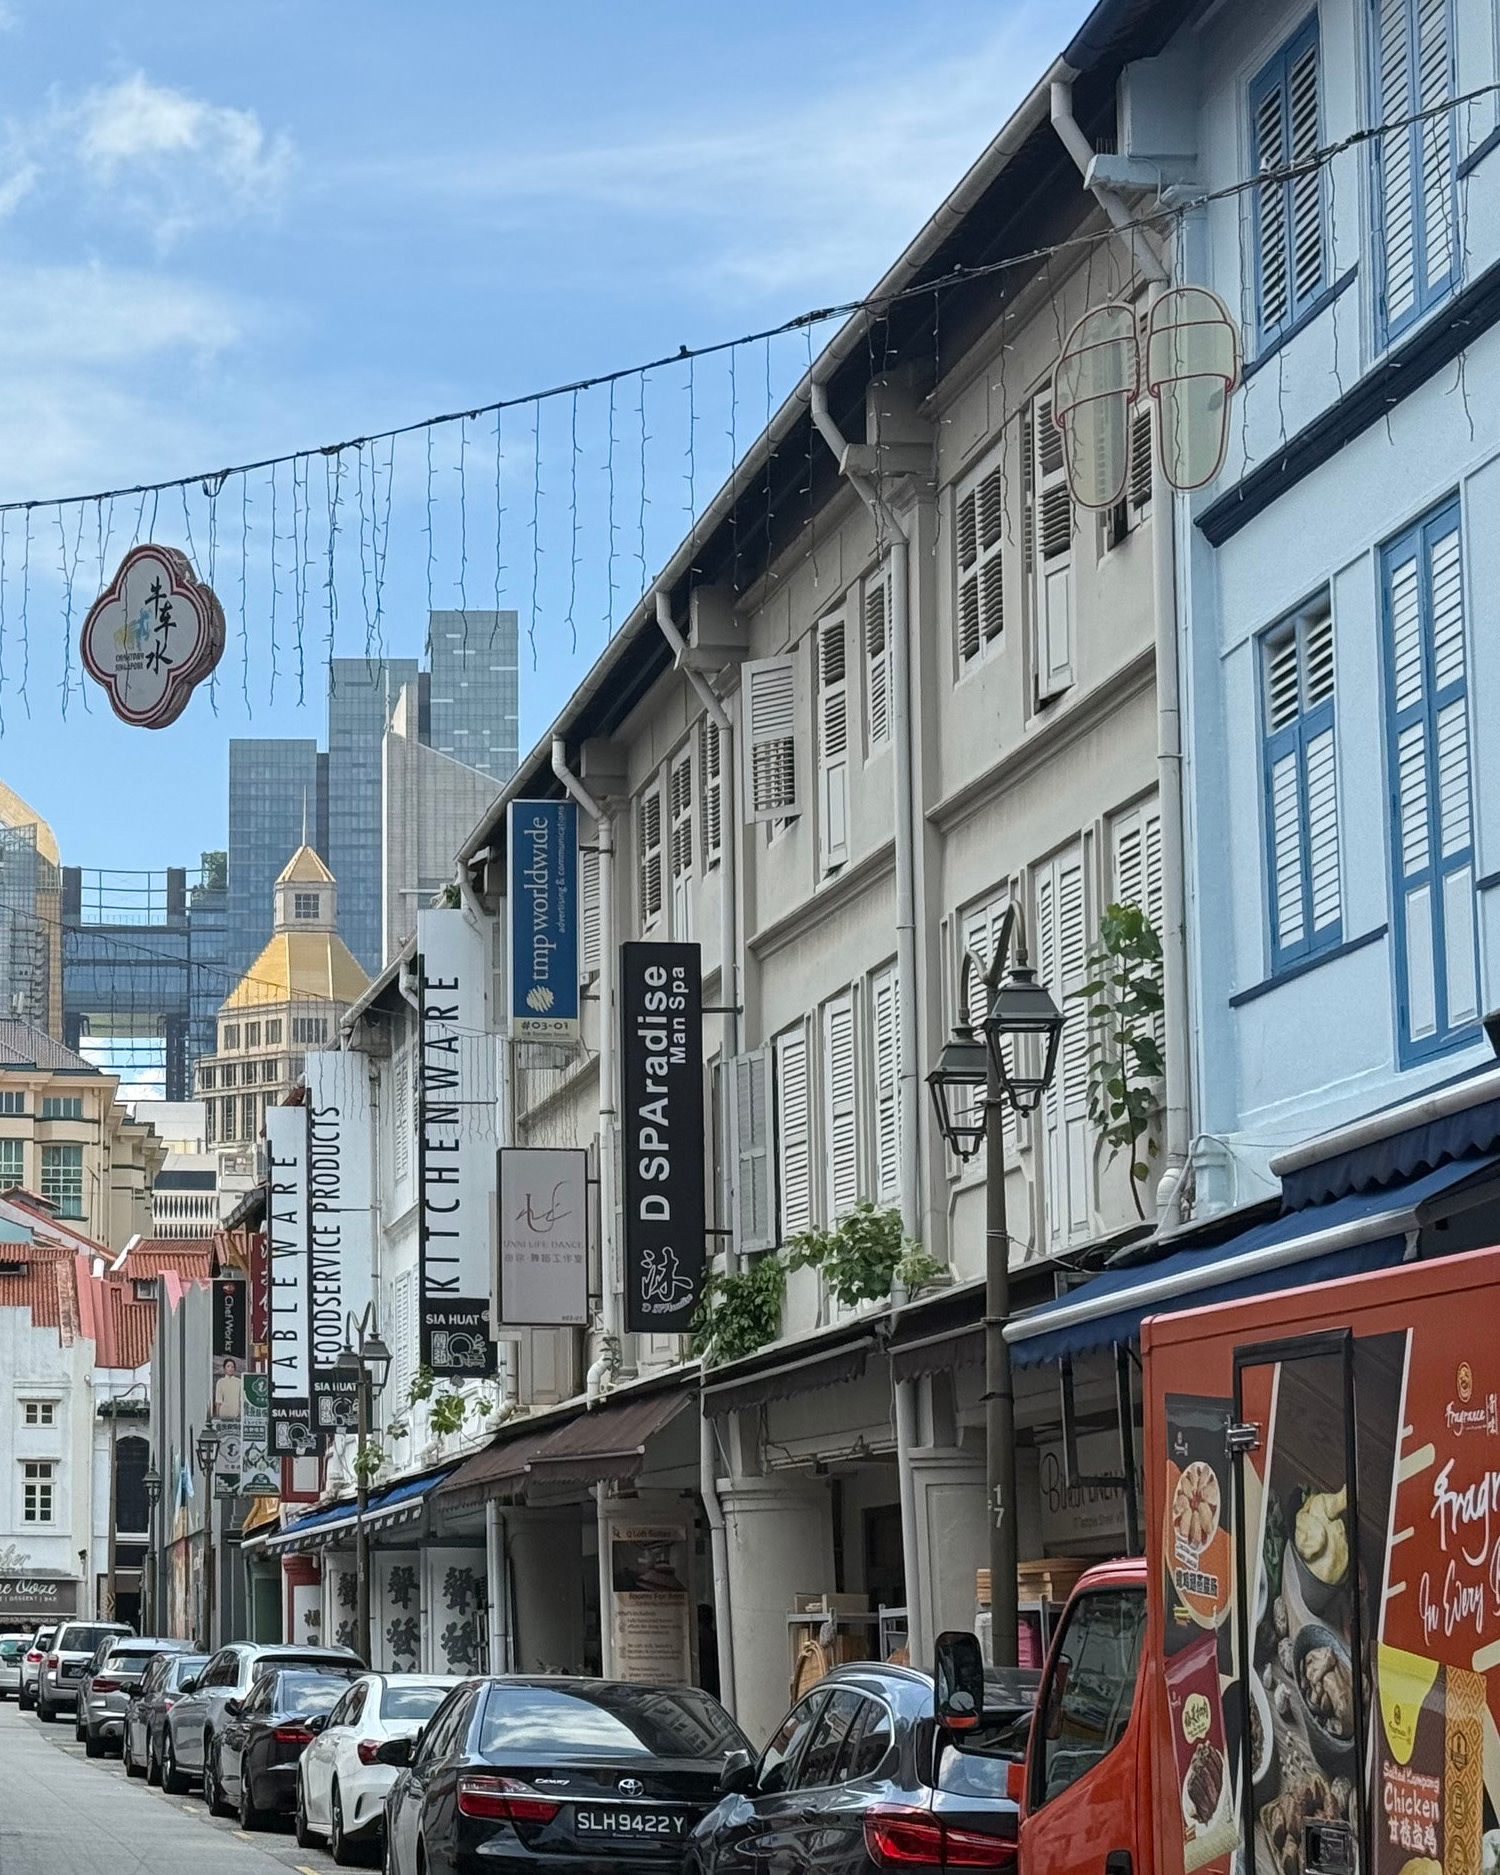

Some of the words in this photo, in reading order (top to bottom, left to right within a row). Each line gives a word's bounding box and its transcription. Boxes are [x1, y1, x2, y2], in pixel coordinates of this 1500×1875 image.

[144, 575, 177, 675] 牛车水
[558, 805, 566, 877] communications
[523, 816, 549, 932] worldwide
[558, 889, 568, 933] advertising
[533, 938, 557, 981] tmp
[670, 966, 688, 1010] Spa
[521, 1021, 569, 1031] #03-01
[669, 1017, 686, 1064] Man
[637, 965, 671, 1182] SPAradise
[424, 976, 461, 1296] KITCHENWARE
[312, 1106, 341, 1214] PRODUCTS
[639, 1194, 671, 1221] D
[271, 1155, 298, 1391] TABLEWARE
[312, 1224, 342, 1370] FOODSERVICE
[425, 1314, 446, 1325] SIA
[448, 1315, 480, 1326] HUAT
[313, 1382, 331, 1392] SIA
[271, 1408, 288, 1418] SIA
[15, 1579, 58, 1595] Ooze
[1442, 1559, 1485, 1637] Every
[1383, 1781, 1441, 1823] Chicken
